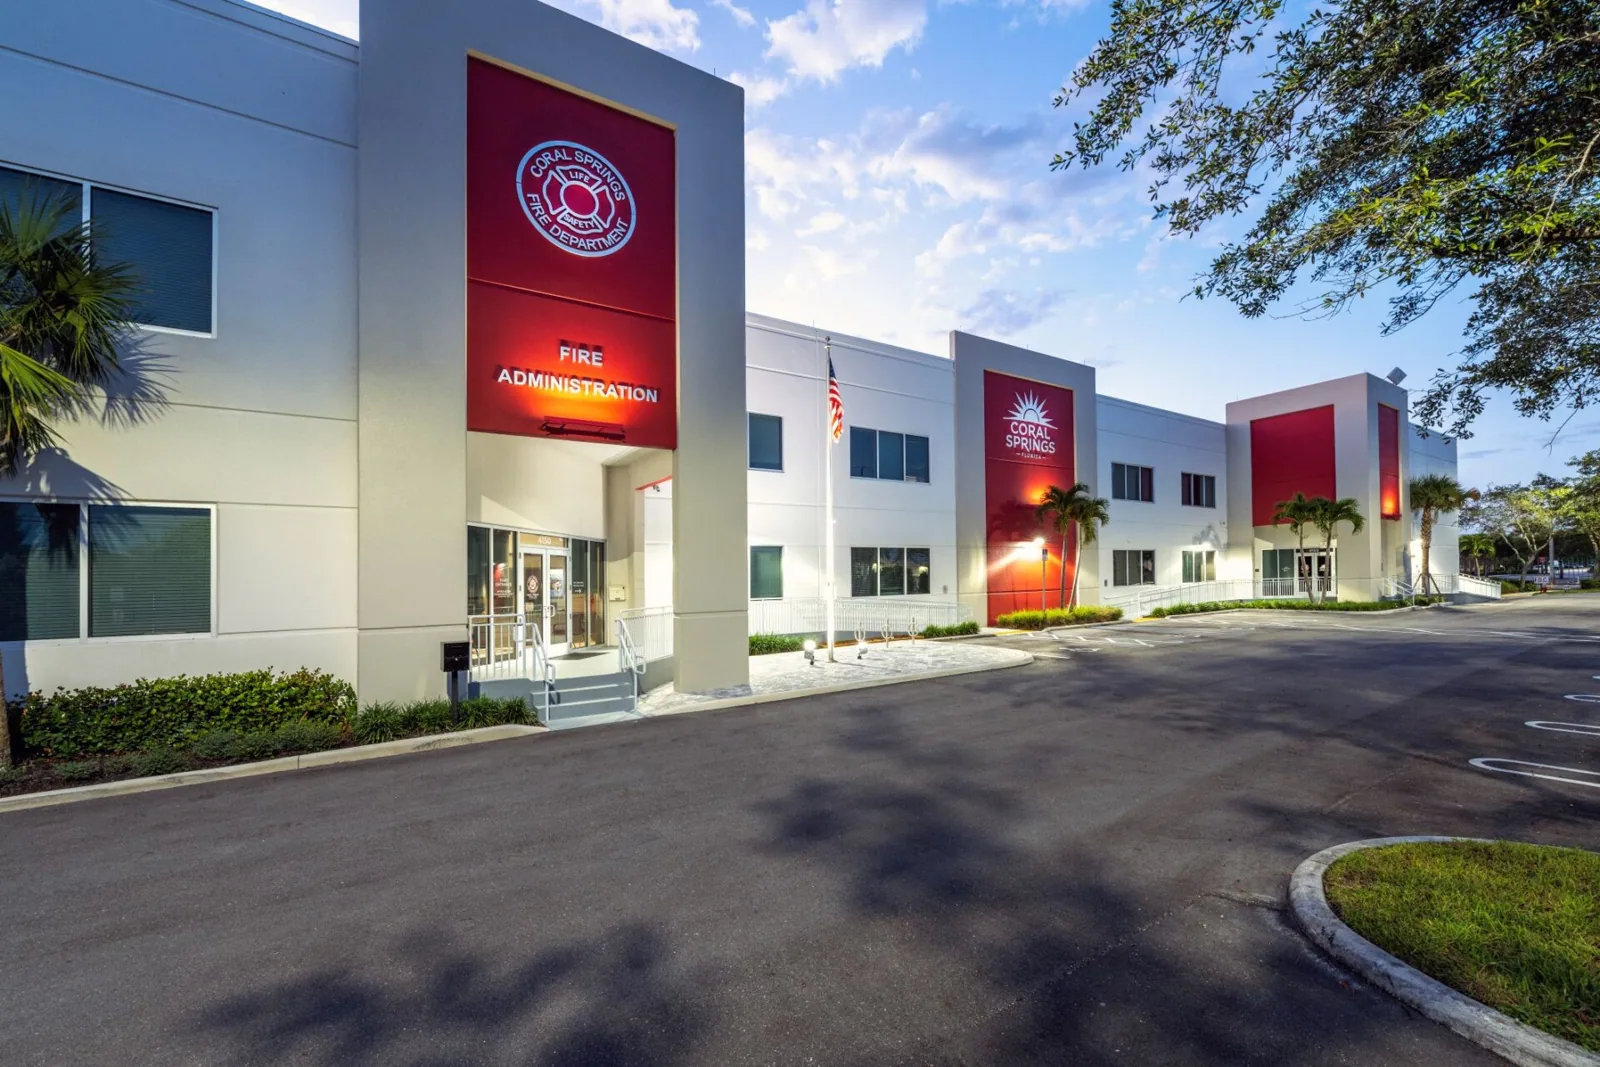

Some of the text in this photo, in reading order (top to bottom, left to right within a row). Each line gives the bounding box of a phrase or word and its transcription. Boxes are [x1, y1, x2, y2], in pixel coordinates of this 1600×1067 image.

[531, 149, 625, 201] CORAL SPRINGS
[569, 172, 590, 183] LIFE
[527, 193, 629, 251] FIRE DEPARTMENT
[563, 213, 596, 229] SAFETY
[559, 346, 603, 366] FIRE
[498, 369, 658, 403] ADMINISTRATION
[1010, 422, 1051, 440] CORAL
[1005, 434, 1056, 454] SPRINGS
[1021, 452, 1042, 460] FLORIDA
